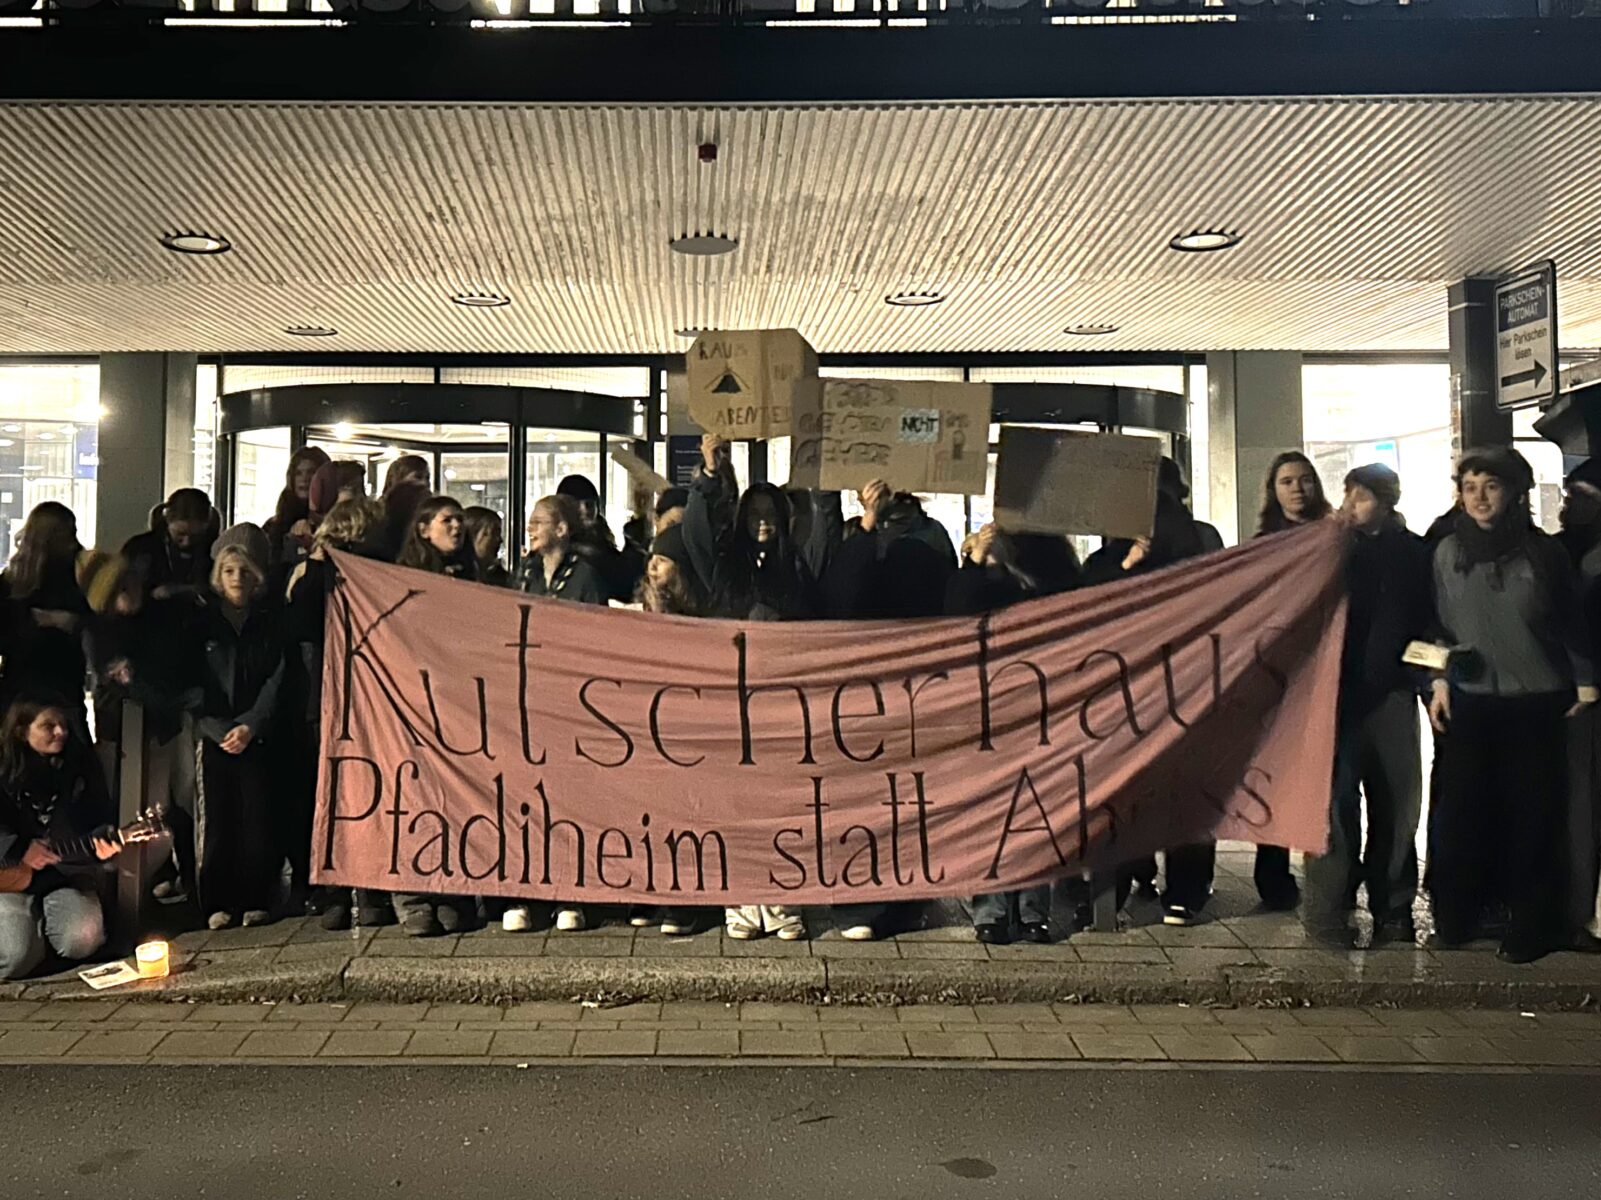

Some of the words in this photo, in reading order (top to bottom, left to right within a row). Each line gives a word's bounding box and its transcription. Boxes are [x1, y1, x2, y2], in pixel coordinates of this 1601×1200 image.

[1507, 302, 1538, 323] AUTOMAT
[335, 578, 1290, 770] Kutscherhaus
[321, 755, 730, 893] Pfadiheim
[768, 772, 945, 889] statt
